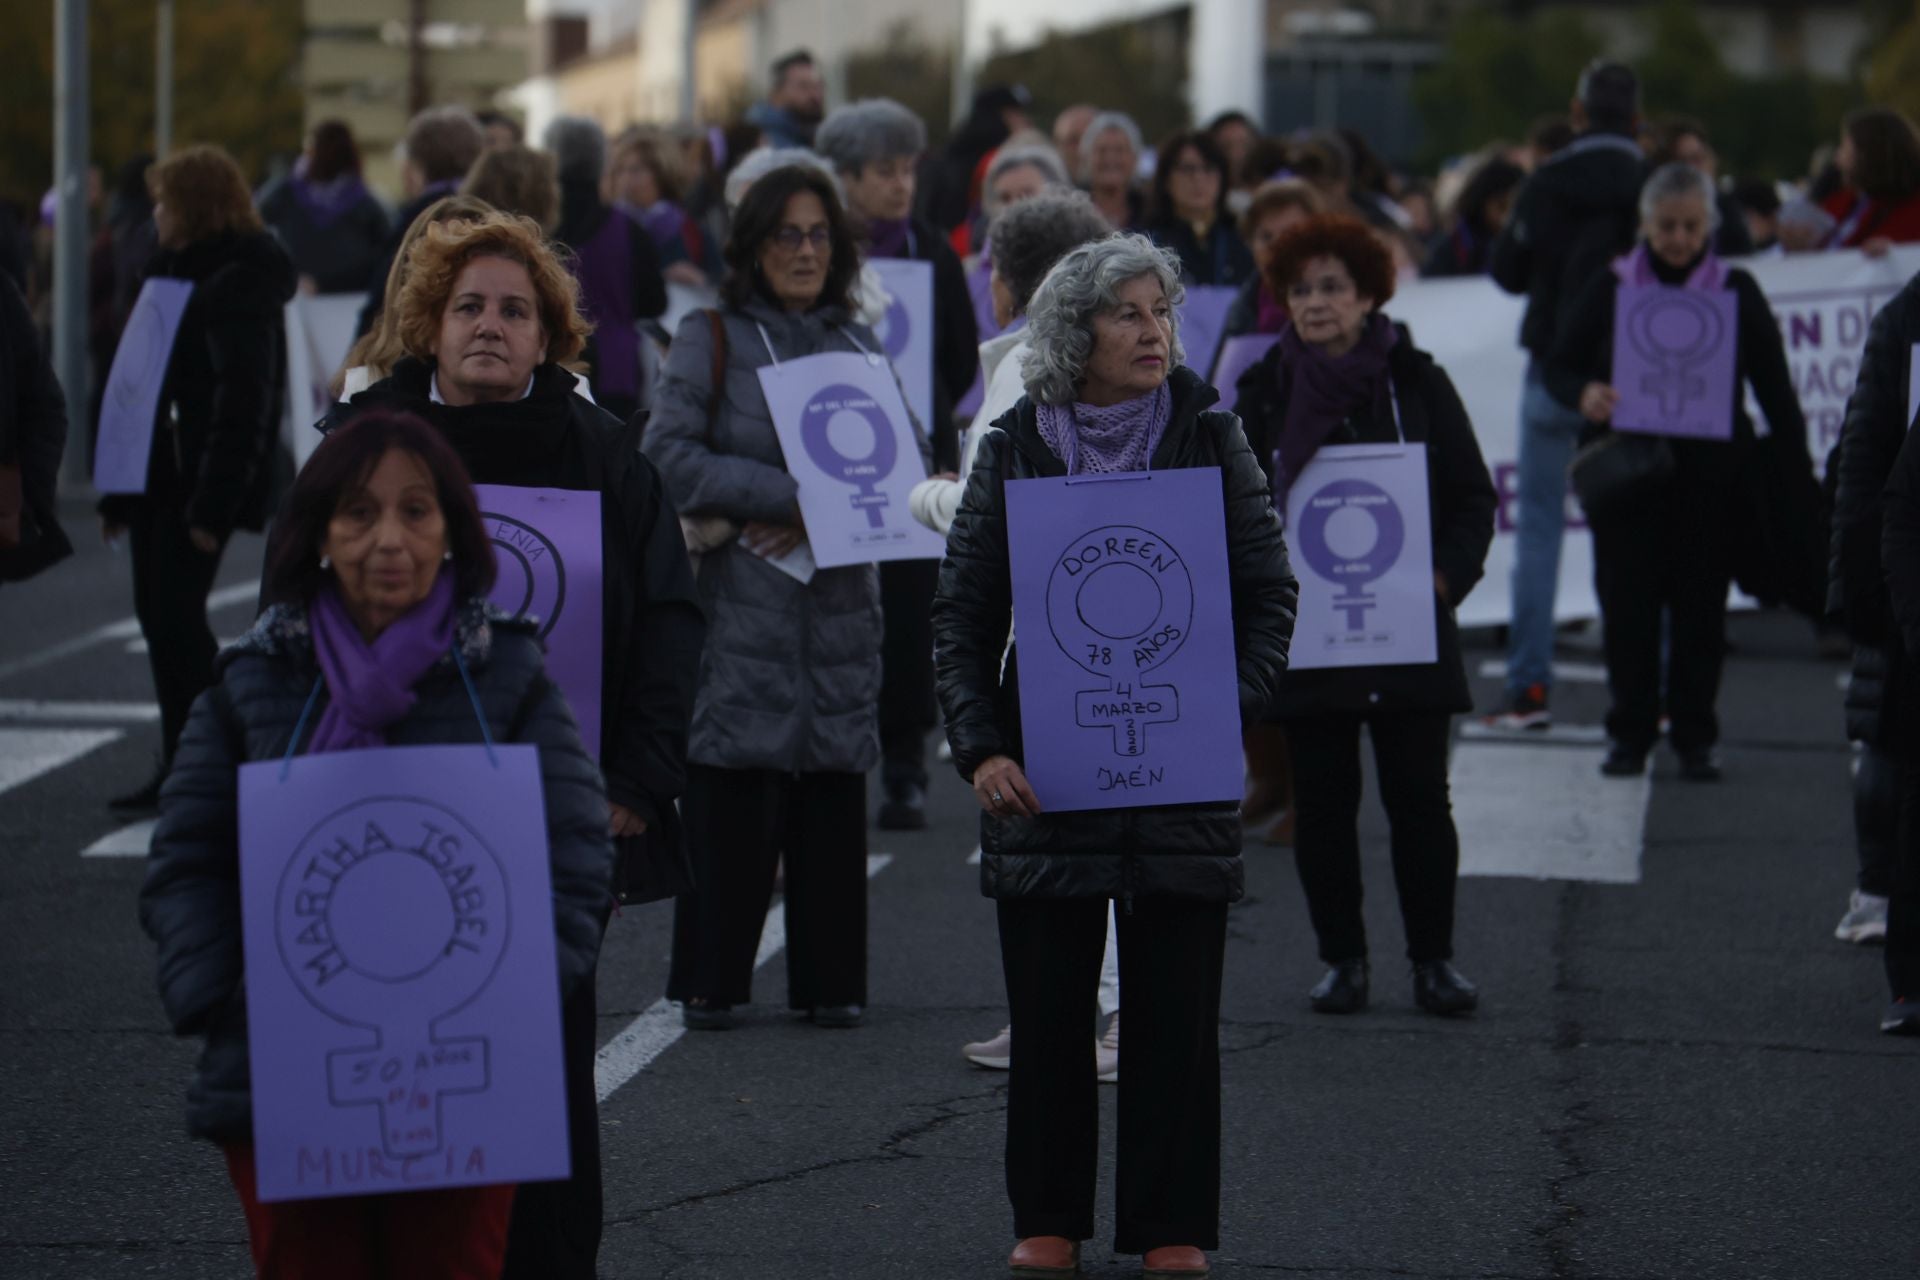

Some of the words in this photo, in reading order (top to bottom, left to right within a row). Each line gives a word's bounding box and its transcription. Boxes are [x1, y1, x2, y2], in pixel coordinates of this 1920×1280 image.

[1062, 538, 1176, 576] DOREEN
[1086, 643, 1112, 665] 78
[1133, 624, 1181, 667] AÑOS
[1092, 702, 1162, 718] MARZO
[1116, 682, 1132, 700] 4
[1097, 764, 1164, 791] JAÉN
[295, 820, 397, 987] MARTHA
[411, 821, 488, 958] ISABEL
[298, 1146, 486, 1186] MURCIA
